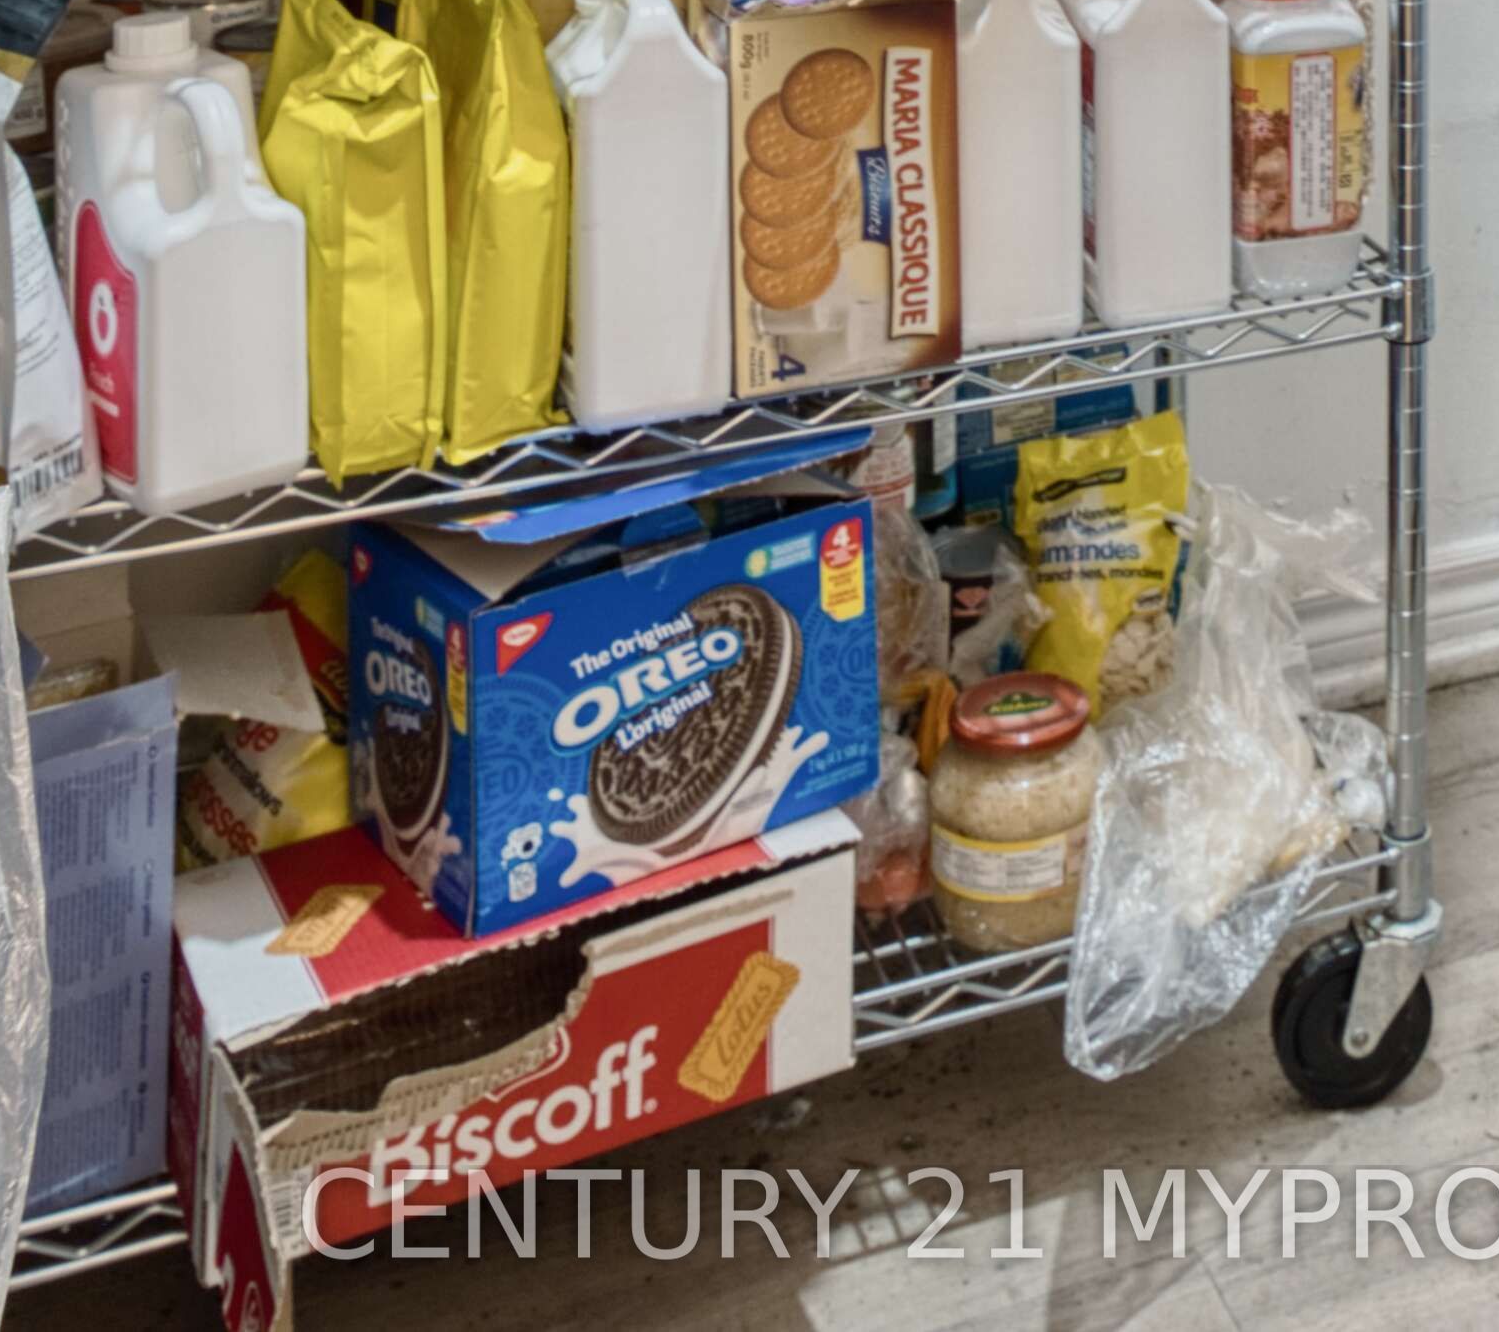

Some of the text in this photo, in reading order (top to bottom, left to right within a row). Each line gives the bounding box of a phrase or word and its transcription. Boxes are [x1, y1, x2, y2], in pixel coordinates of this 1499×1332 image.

[865, 155, 888, 238] Biscuits
[892, 57, 929, 328] MARIA CLASSIQUE
[771, 353, 806, 382] 4
[832, 524, 850, 548] 4
[365, 650, 433, 707] OREO
[569, 612, 694, 680] The Original
[553, 630, 740, 748] OREO
[614, 679, 714, 753] L'original
[714, 976, 772, 1066] Lotus
[367, 1025, 659, 1209] Biscoff
